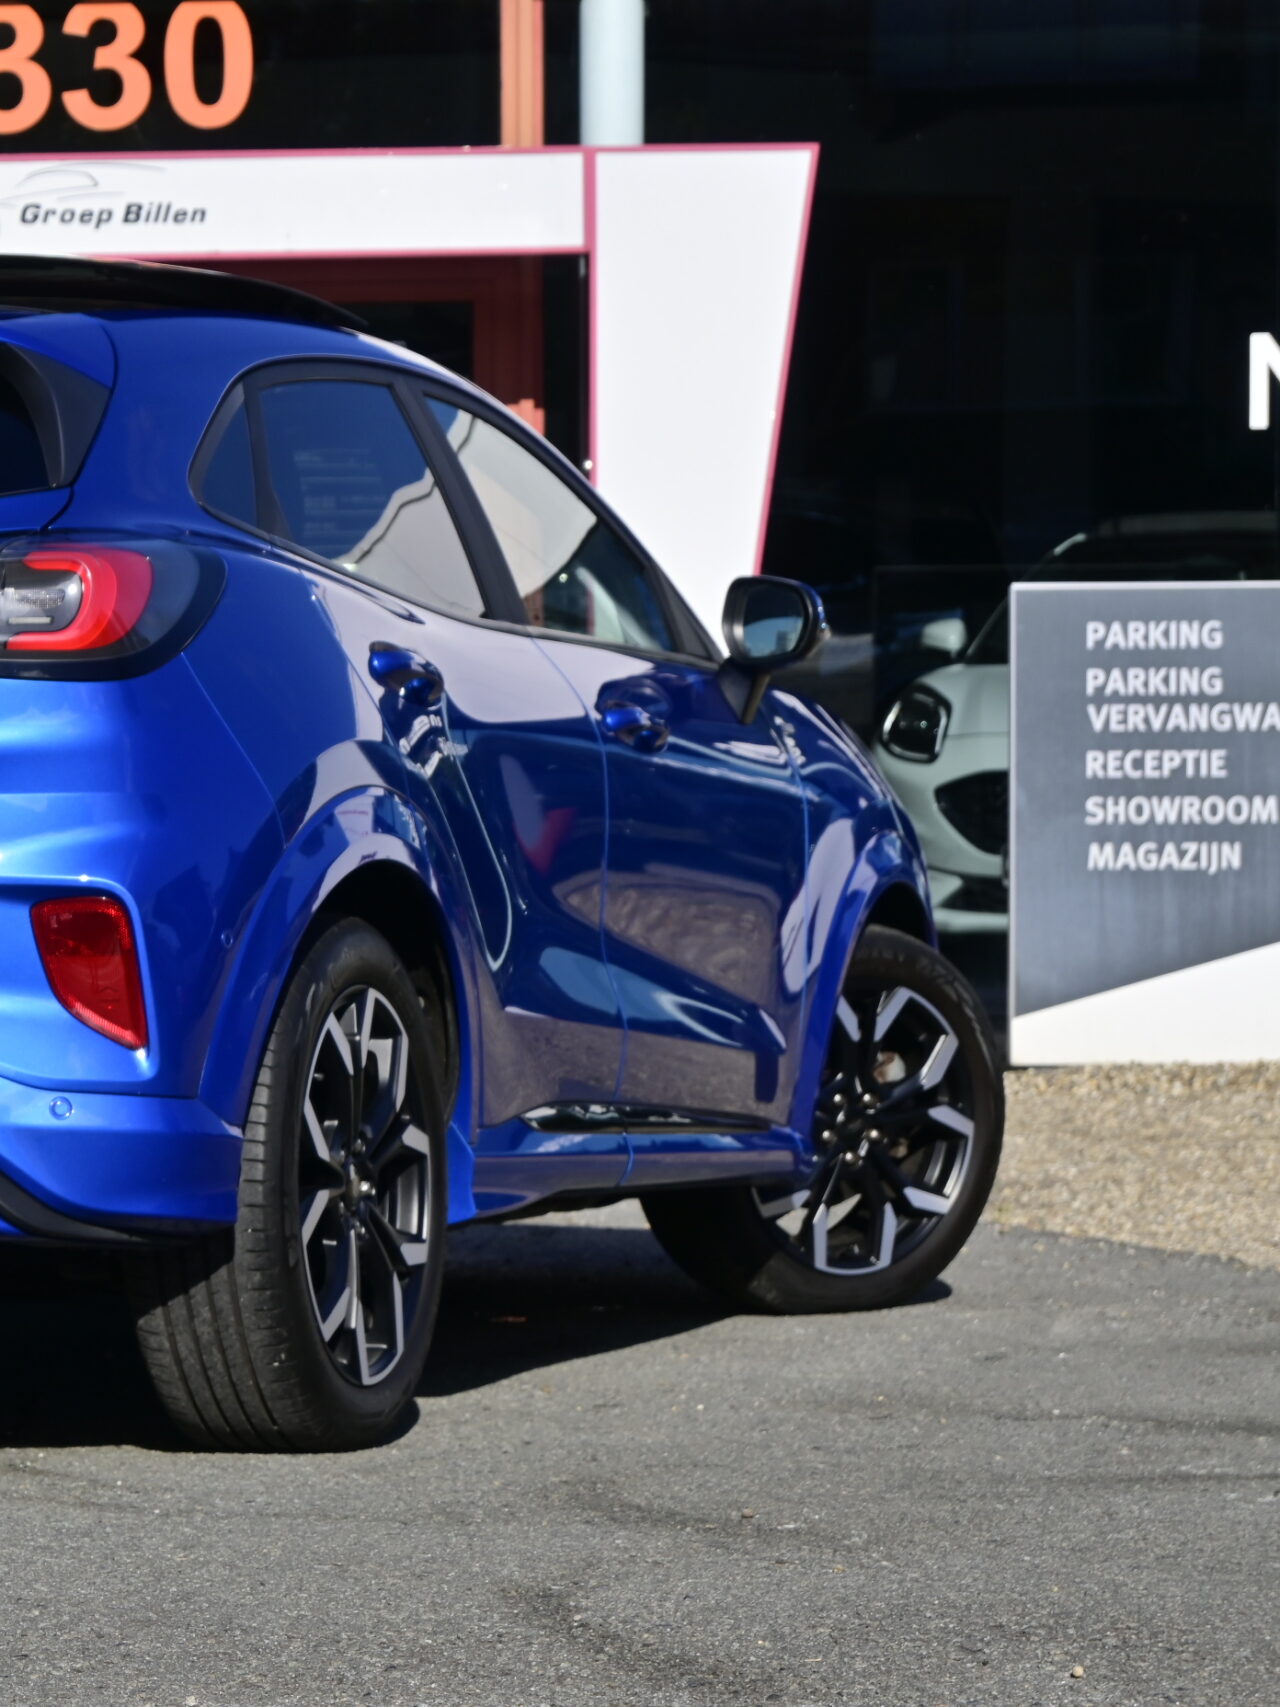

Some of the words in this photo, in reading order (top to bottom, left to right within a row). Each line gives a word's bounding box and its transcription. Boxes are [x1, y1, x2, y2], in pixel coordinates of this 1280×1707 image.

[19, 203, 113, 230] Groep
[122, 202, 207, 224] Billen
[1085, 620, 1224, 650] PARKING
[1085, 666, 1224, 697] PARKING
[1087, 702, 1280, 733] VERVANGWA
[1085, 749, 1228, 779] RECEPTIE
[1084, 795, 1280, 825] SHOWROOM
[1087, 841, 1242, 876] MAGAZIJN
